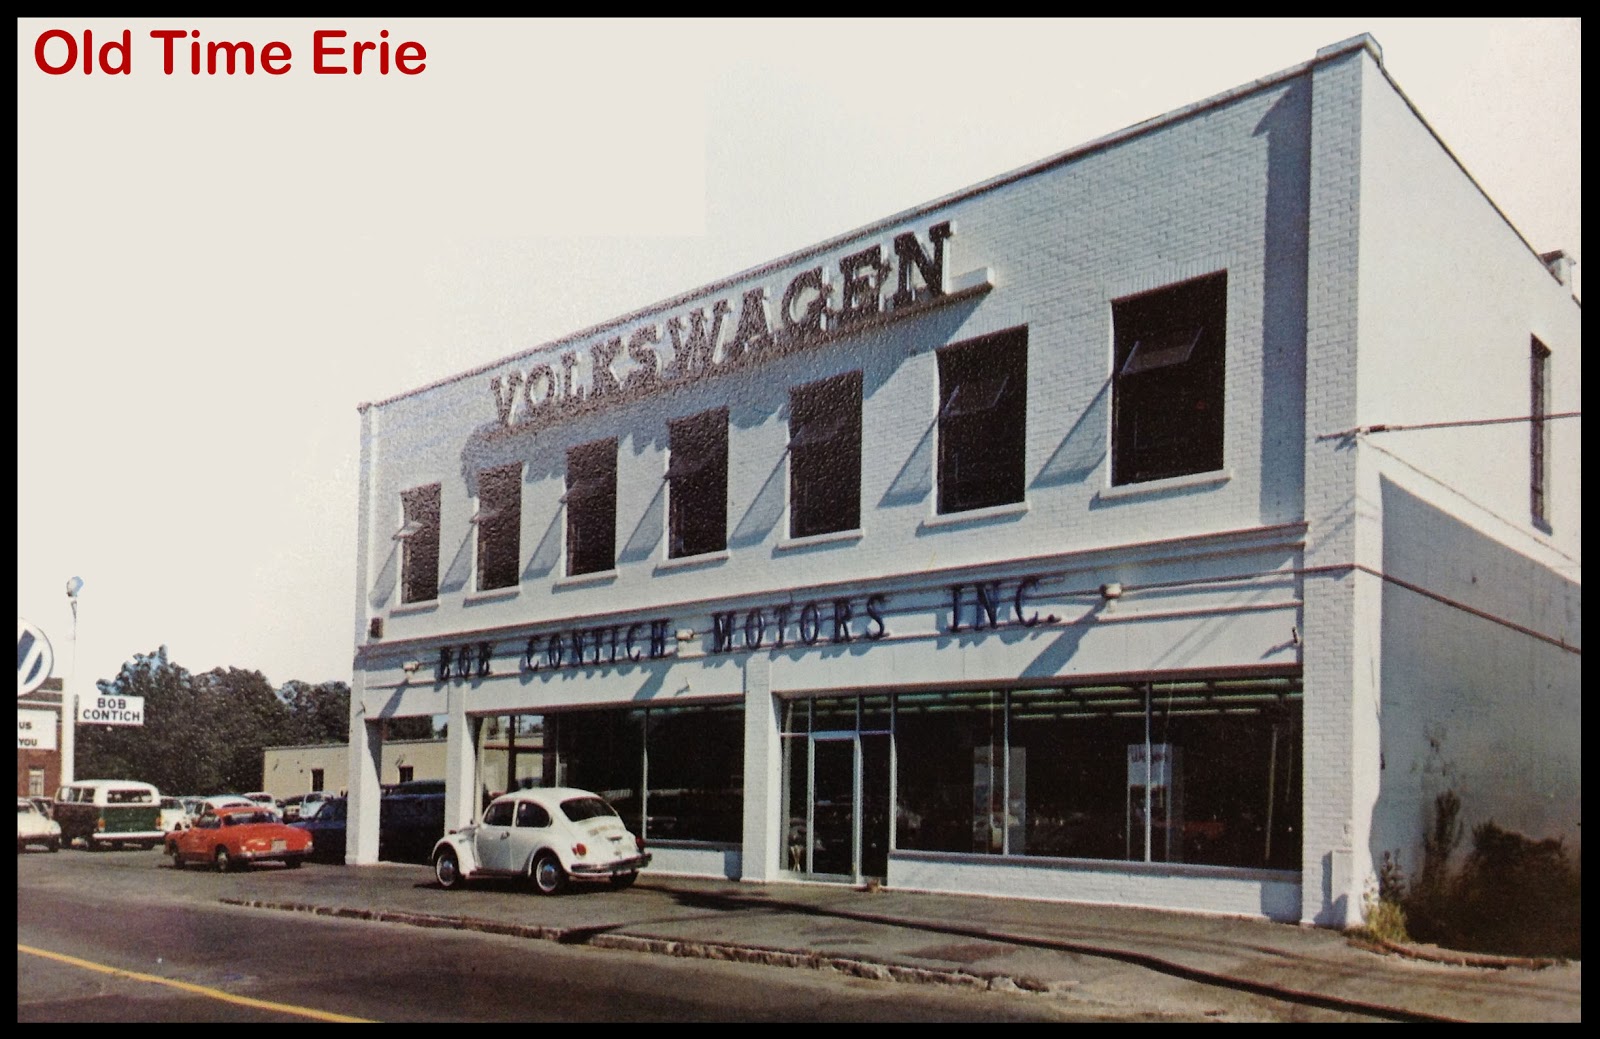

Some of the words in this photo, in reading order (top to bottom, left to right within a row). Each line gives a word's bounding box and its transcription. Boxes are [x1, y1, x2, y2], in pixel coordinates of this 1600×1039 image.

[490, 221, 954, 425] VOLKSWAGEN
[439, 640, 494, 681] BOB
[525, 617, 671, 672] CONTICH
[712, 593, 890, 652] MOTORS
[950, 576, 1061, 631] INC.
[97, 697, 126, 709] BOB
[83, 708, 140, 721] CONTICH
[18, 738, 38, 746] YOU
